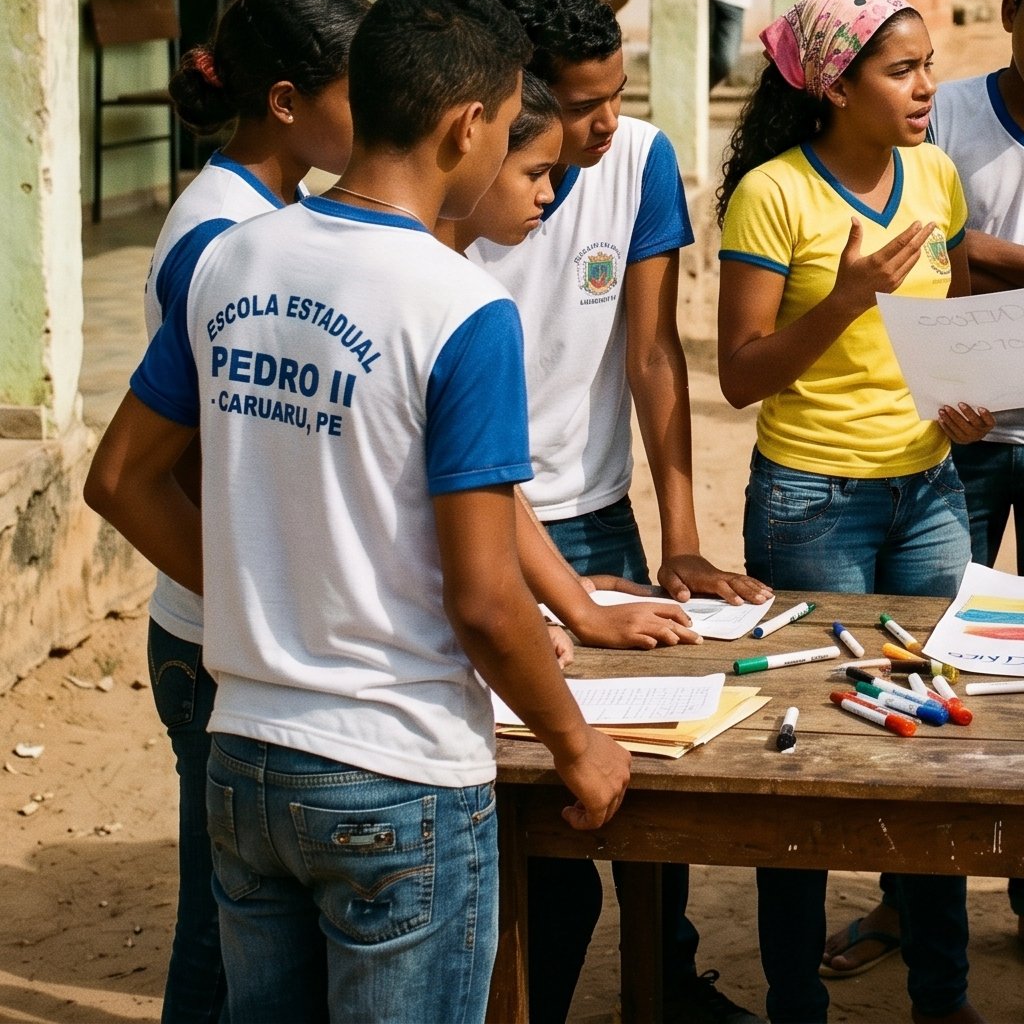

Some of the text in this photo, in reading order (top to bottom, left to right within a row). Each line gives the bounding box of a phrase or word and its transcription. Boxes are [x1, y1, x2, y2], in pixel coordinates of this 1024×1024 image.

[206, 293, 381, 374] ESCOLA ESTADUAL
[211, 345, 357, 409] PEDRO II
[218, 390, 311, 436] CARUARU,
[315, 411, 343, 437] PE
